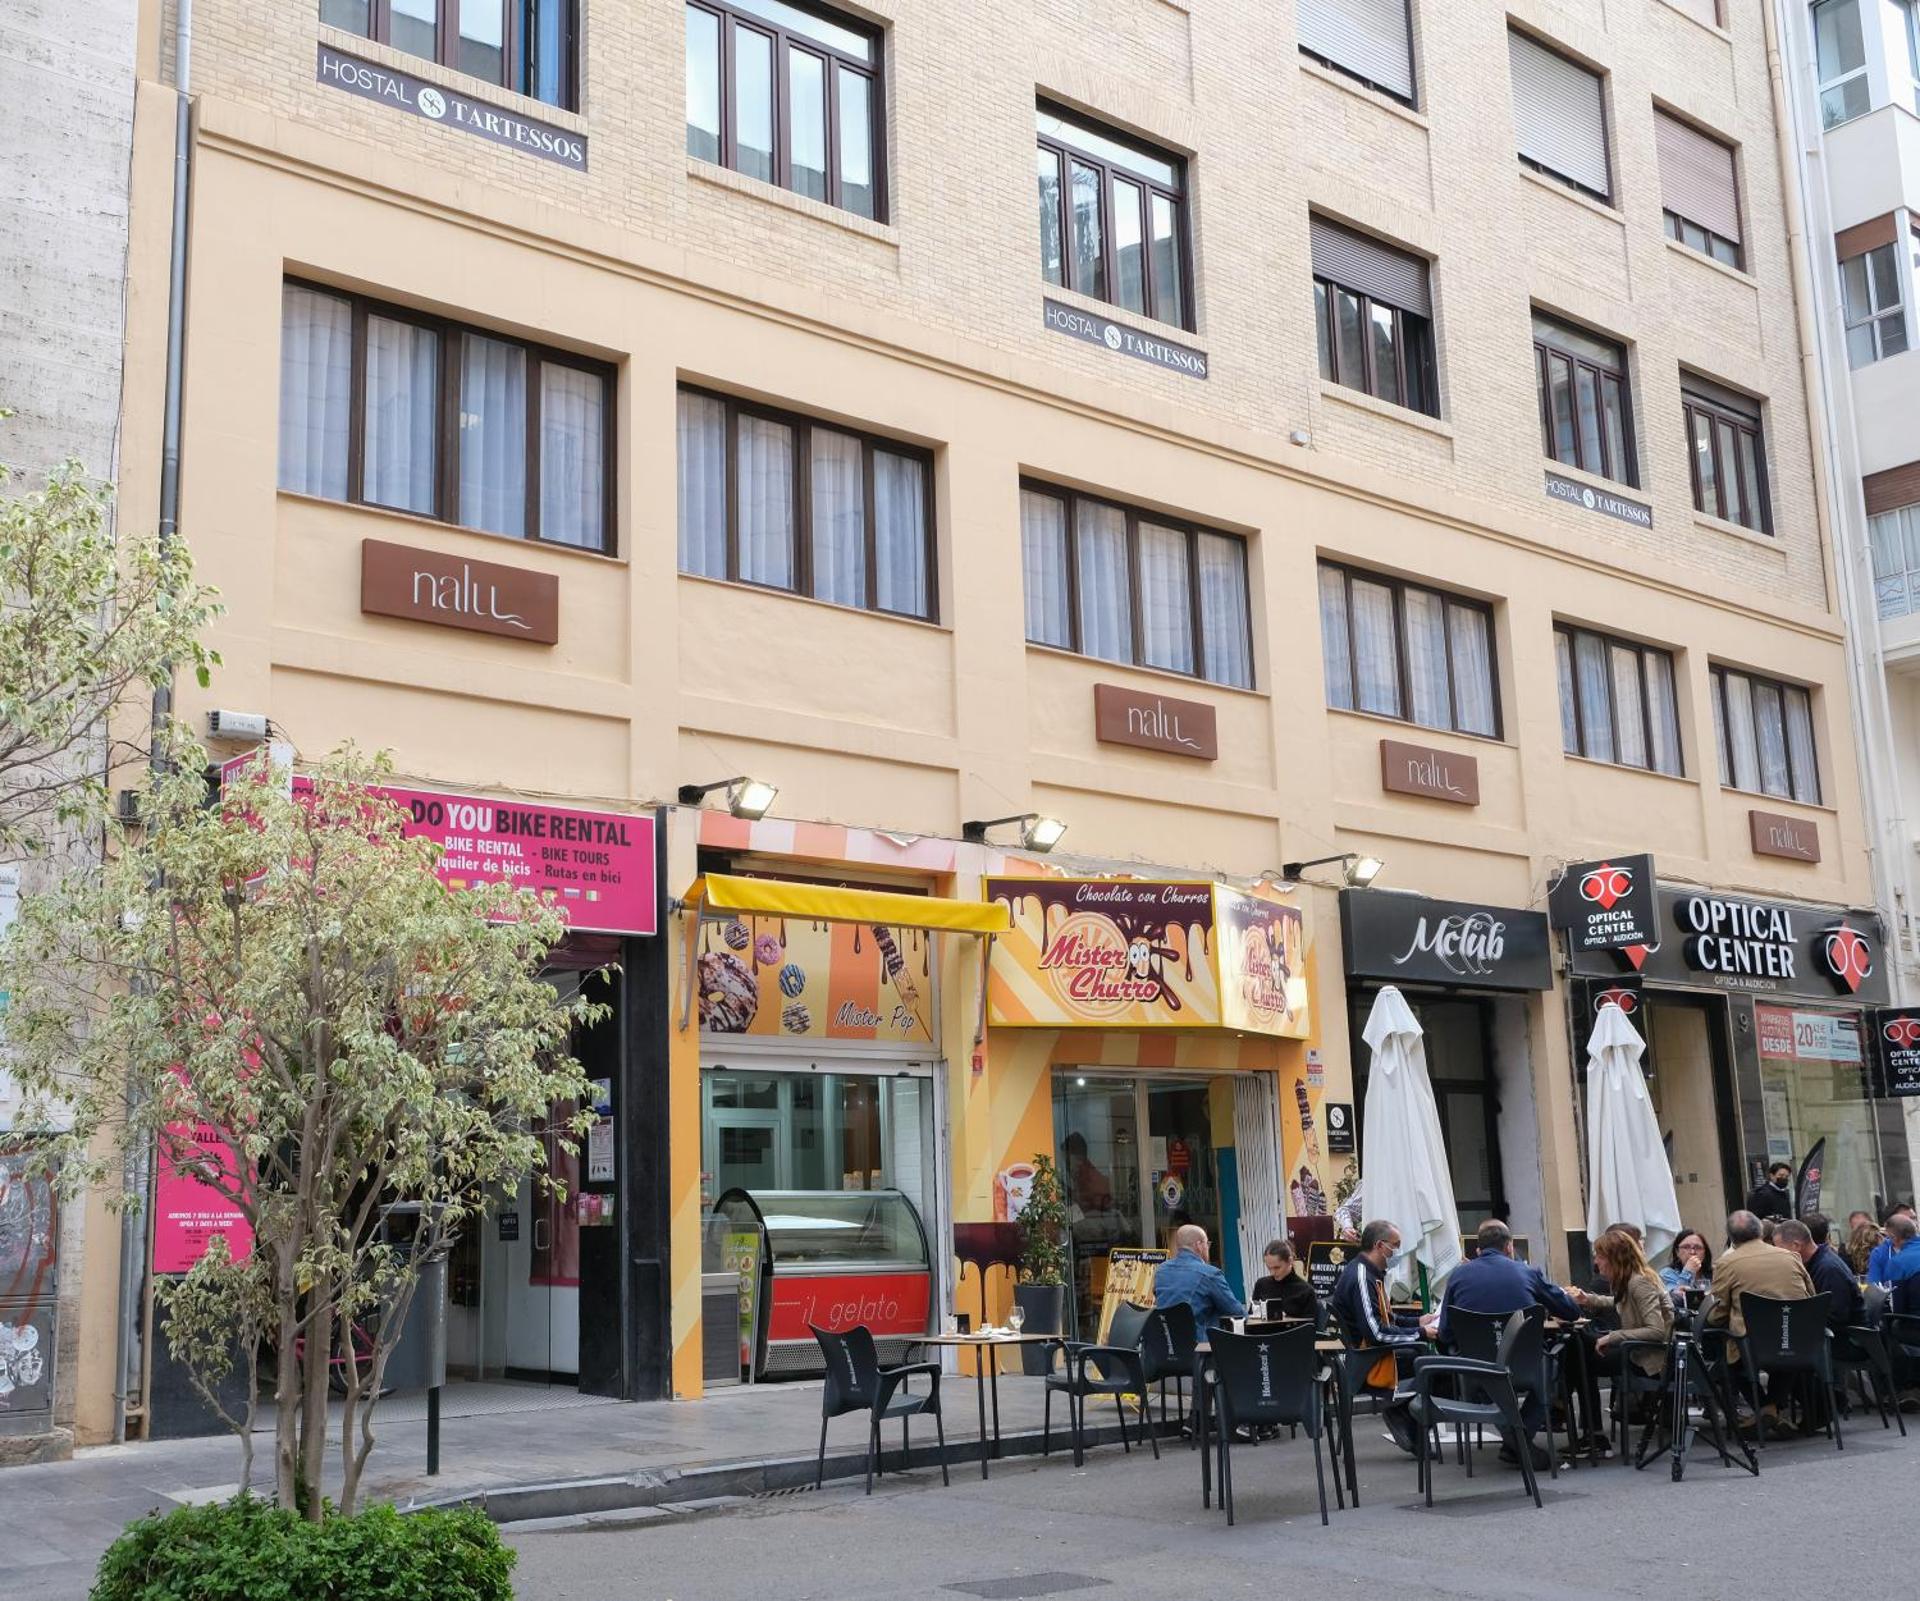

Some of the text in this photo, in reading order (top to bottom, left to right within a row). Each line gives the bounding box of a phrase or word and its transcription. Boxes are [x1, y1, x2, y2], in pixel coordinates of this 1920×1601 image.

[323, 55, 582, 162] HOSTAL TARTESSOS
[1046, 306, 1206, 375] HOSTAL TARTESSOS
[1545, 478, 1651, 524] HOSTAL TARTESSOS
[413, 564, 533, 629] nalu
[1128, 699, 1202, 750] nalu
[1408, 752, 1468, 797] nalu
[411, 798, 632, 847] DO YOU BIKE RENTAL
[1769, 817, 1812, 856] nalu
[445, 836, 524, 857] BIKE RENTAL
[542, 847, 568, 862] BIKE
[573, 850, 610, 865] TOURS
[436, 856, 531, 876] lquiler de bicis
[545, 865, 578, 881] Rutas
[582, 870, 597, 881] en
[600, 868, 622, 884] bici
[1075, 883, 1209, 904] Chocolate con Churros
[1588, 910, 1634, 924] OPTICAL
[1588, 921, 1635, 936] CENTER
[1688, 897, 1798, 943] OPTICAL
[1039, 935, 1127, 968] Mister
[1698, 935, 1796, 978] CENTER
[1069, 968, 1160, 1000] Churro
[834, 1001, 915, 1036] Mister Pop
[1796, 1023, 1813, 1047] 20
[1762, 1037, 1792, 1053] DESDE
[802, 1292, 898, 1330] il gelato
[1261, 1355, 1270, 1396] Heineken
